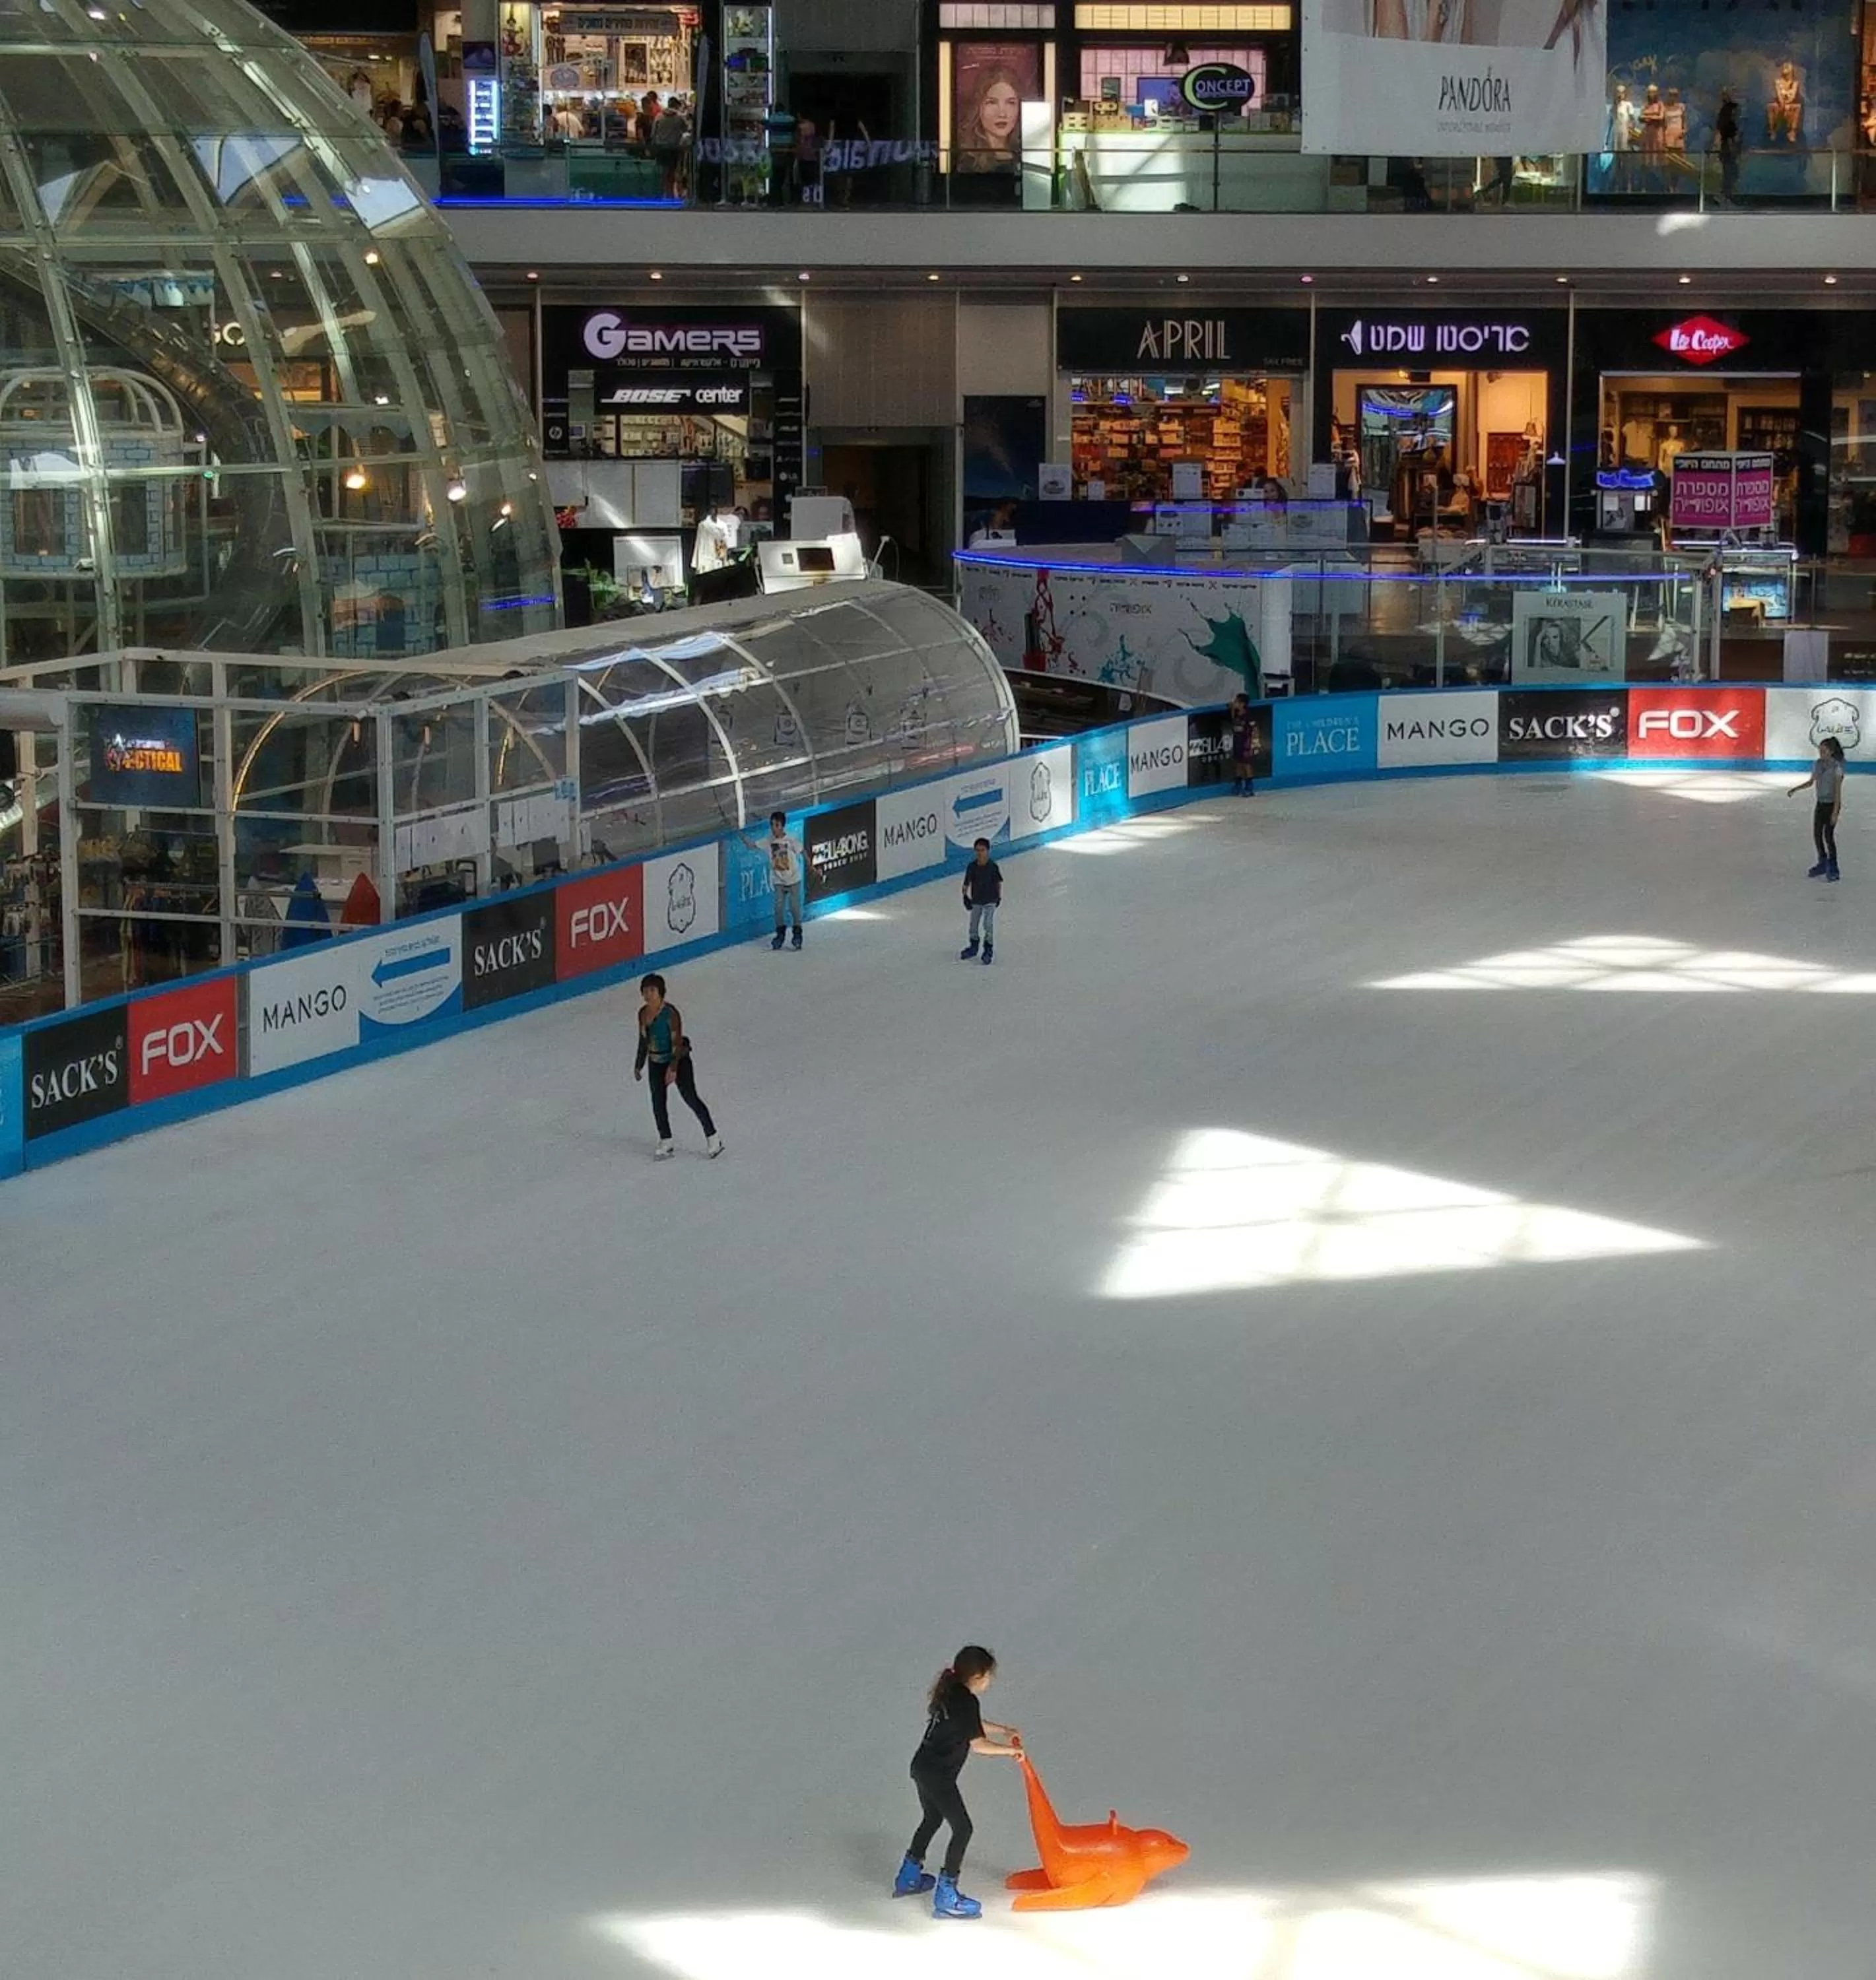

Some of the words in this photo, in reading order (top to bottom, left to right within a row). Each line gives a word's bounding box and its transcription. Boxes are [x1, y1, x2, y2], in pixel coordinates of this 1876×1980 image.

[1184, 67, 1251, 109] CONCEPT
[1137, 320, 1231, 360] APRIL
[1370, 325, 1426, 352] שמט
[1436, 325, 1529, 352] אריסטו
[600, 389, 691, 403] BOSE
[695, 386, 743, 403] center
[1675, 480, 1729, 497] מספרת
[1286, 727, 1360, 757] PLACE
[1387, 718, 1490, 741] MANGO
[1509, 714, 1613, 741] SACK'S
[1638, 710, 1739, 739] FOX
[1131, 744, 1184, 775] MANGO
[1085, 762, 1122, 797] PLACE
[883, 812, 937, 848] MANGO
[740, 865, 775, 902] PLA
[570, 897, 630, 948] FOX
[474, 928, 543, 977] SACK'S
[263, 985, 347, 1034] MANGO
[141, 1013, 224, 1075] FOX
[31, 1051, 119, 1109] SACK'S
